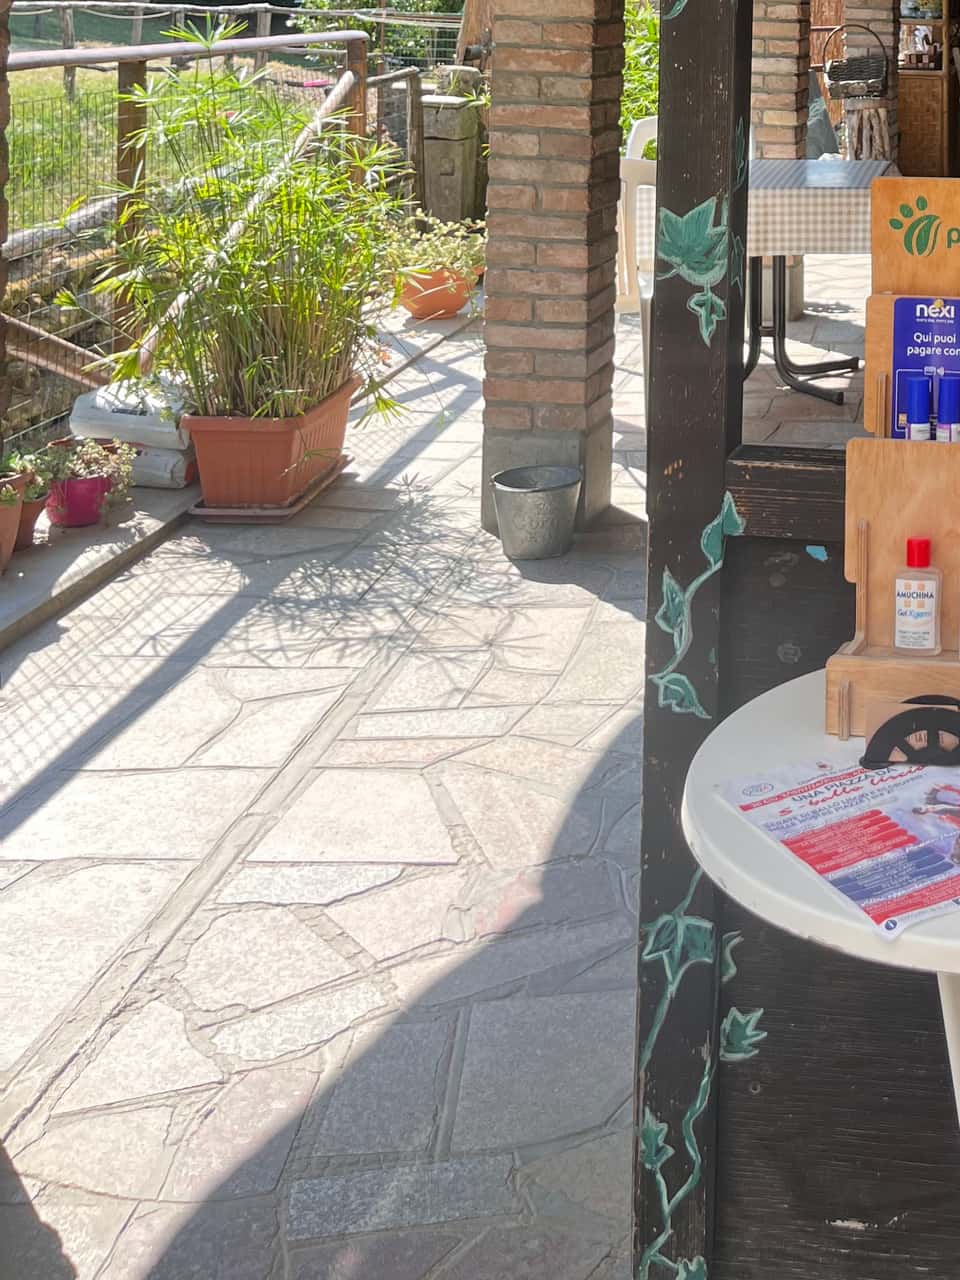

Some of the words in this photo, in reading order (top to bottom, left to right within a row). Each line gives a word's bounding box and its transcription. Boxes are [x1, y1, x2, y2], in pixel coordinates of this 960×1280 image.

[915, 303, 955, 318] nexi
[913, 332, 932, 343] Qui
[934, 334, 956, 345] puoi
[907, 346, 942, 357] pagare
[896, 591, 935, 599] AMUCHINA
